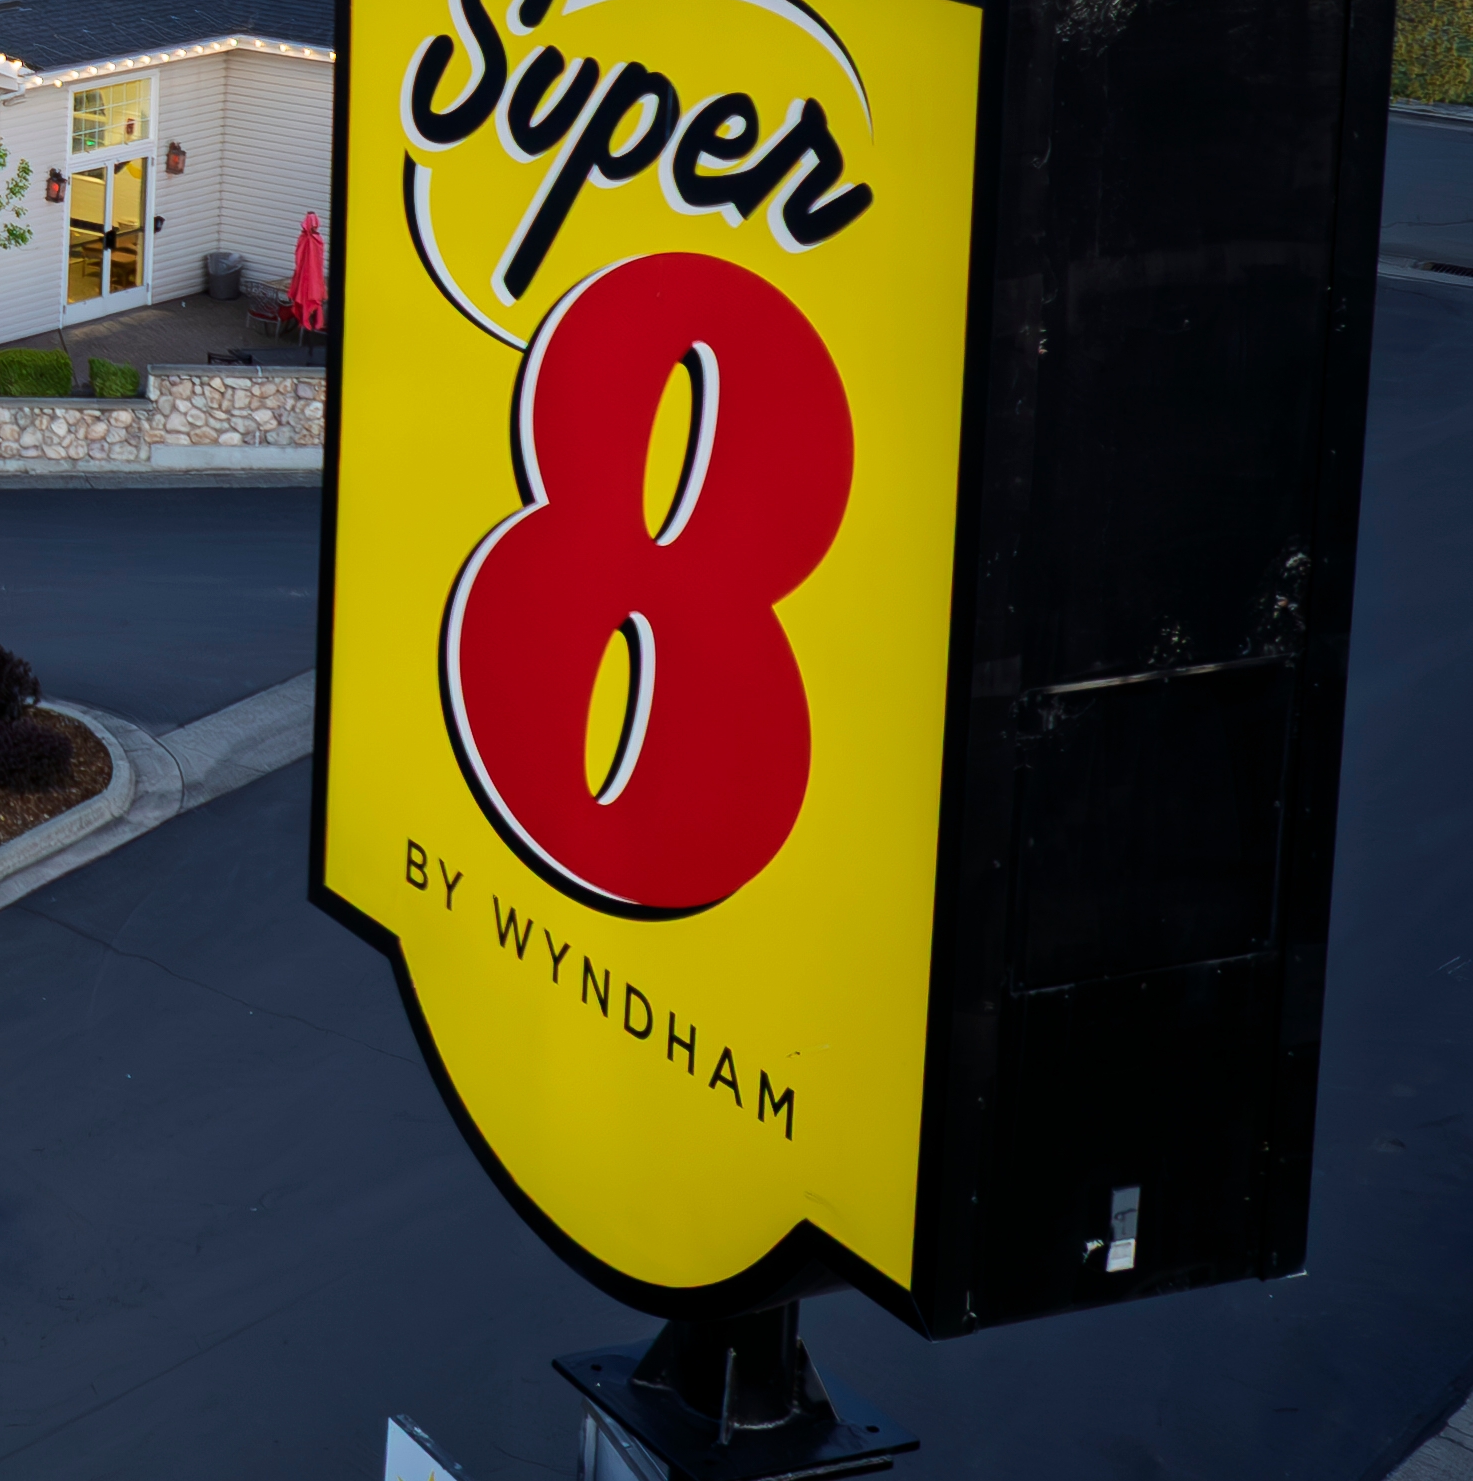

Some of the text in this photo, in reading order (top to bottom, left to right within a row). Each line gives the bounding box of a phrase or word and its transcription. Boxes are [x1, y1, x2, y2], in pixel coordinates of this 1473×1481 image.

[439, 252, 855, 920] 8
[405, 837, 798, 1142] BY WYNDHAM
